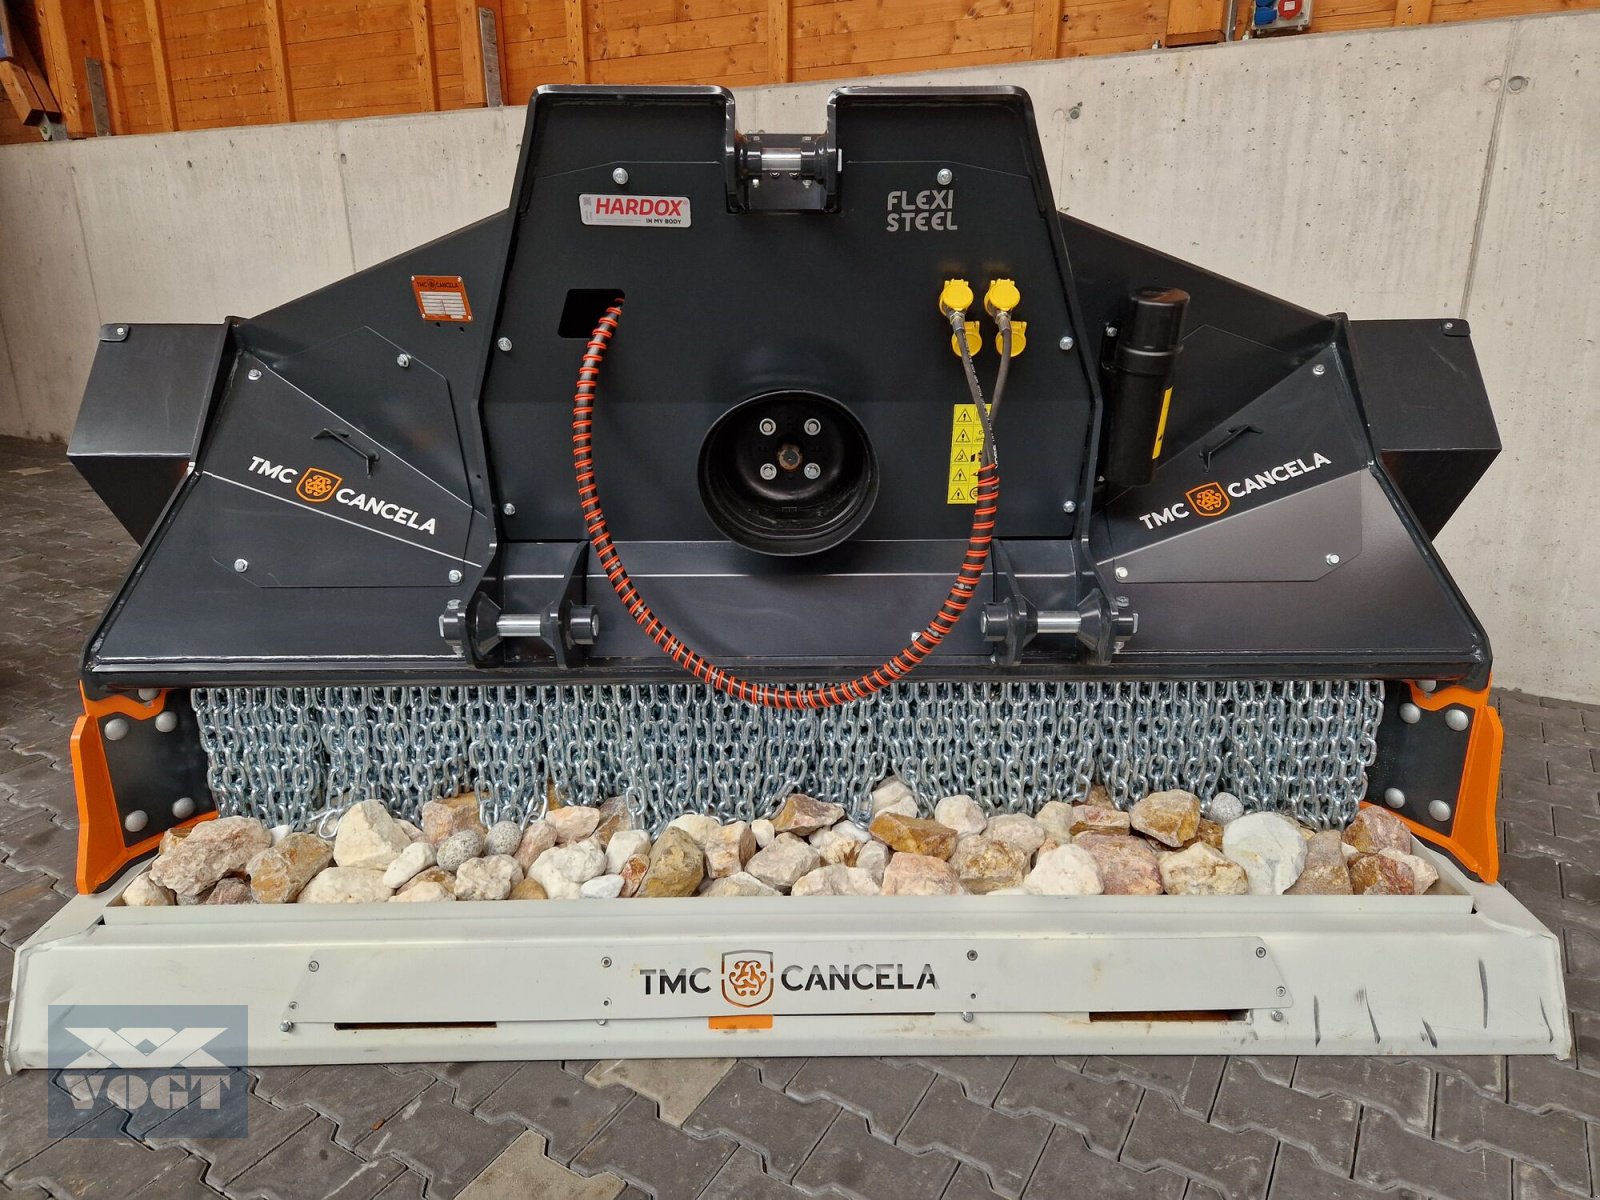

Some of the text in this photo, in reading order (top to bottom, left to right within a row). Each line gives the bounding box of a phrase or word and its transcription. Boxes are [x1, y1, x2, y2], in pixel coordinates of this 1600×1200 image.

[595, 197, 683, 216] HARDOX
[887, 189, 954, 211] FLEXI
[886, 211, 958, 232] STEEL
[248, 455, 436, 535] TMC CANCELA
[1139, 452, 1332, 530] TMC CANCELA
[639, 963, 940, 995] TMC CANCELA
